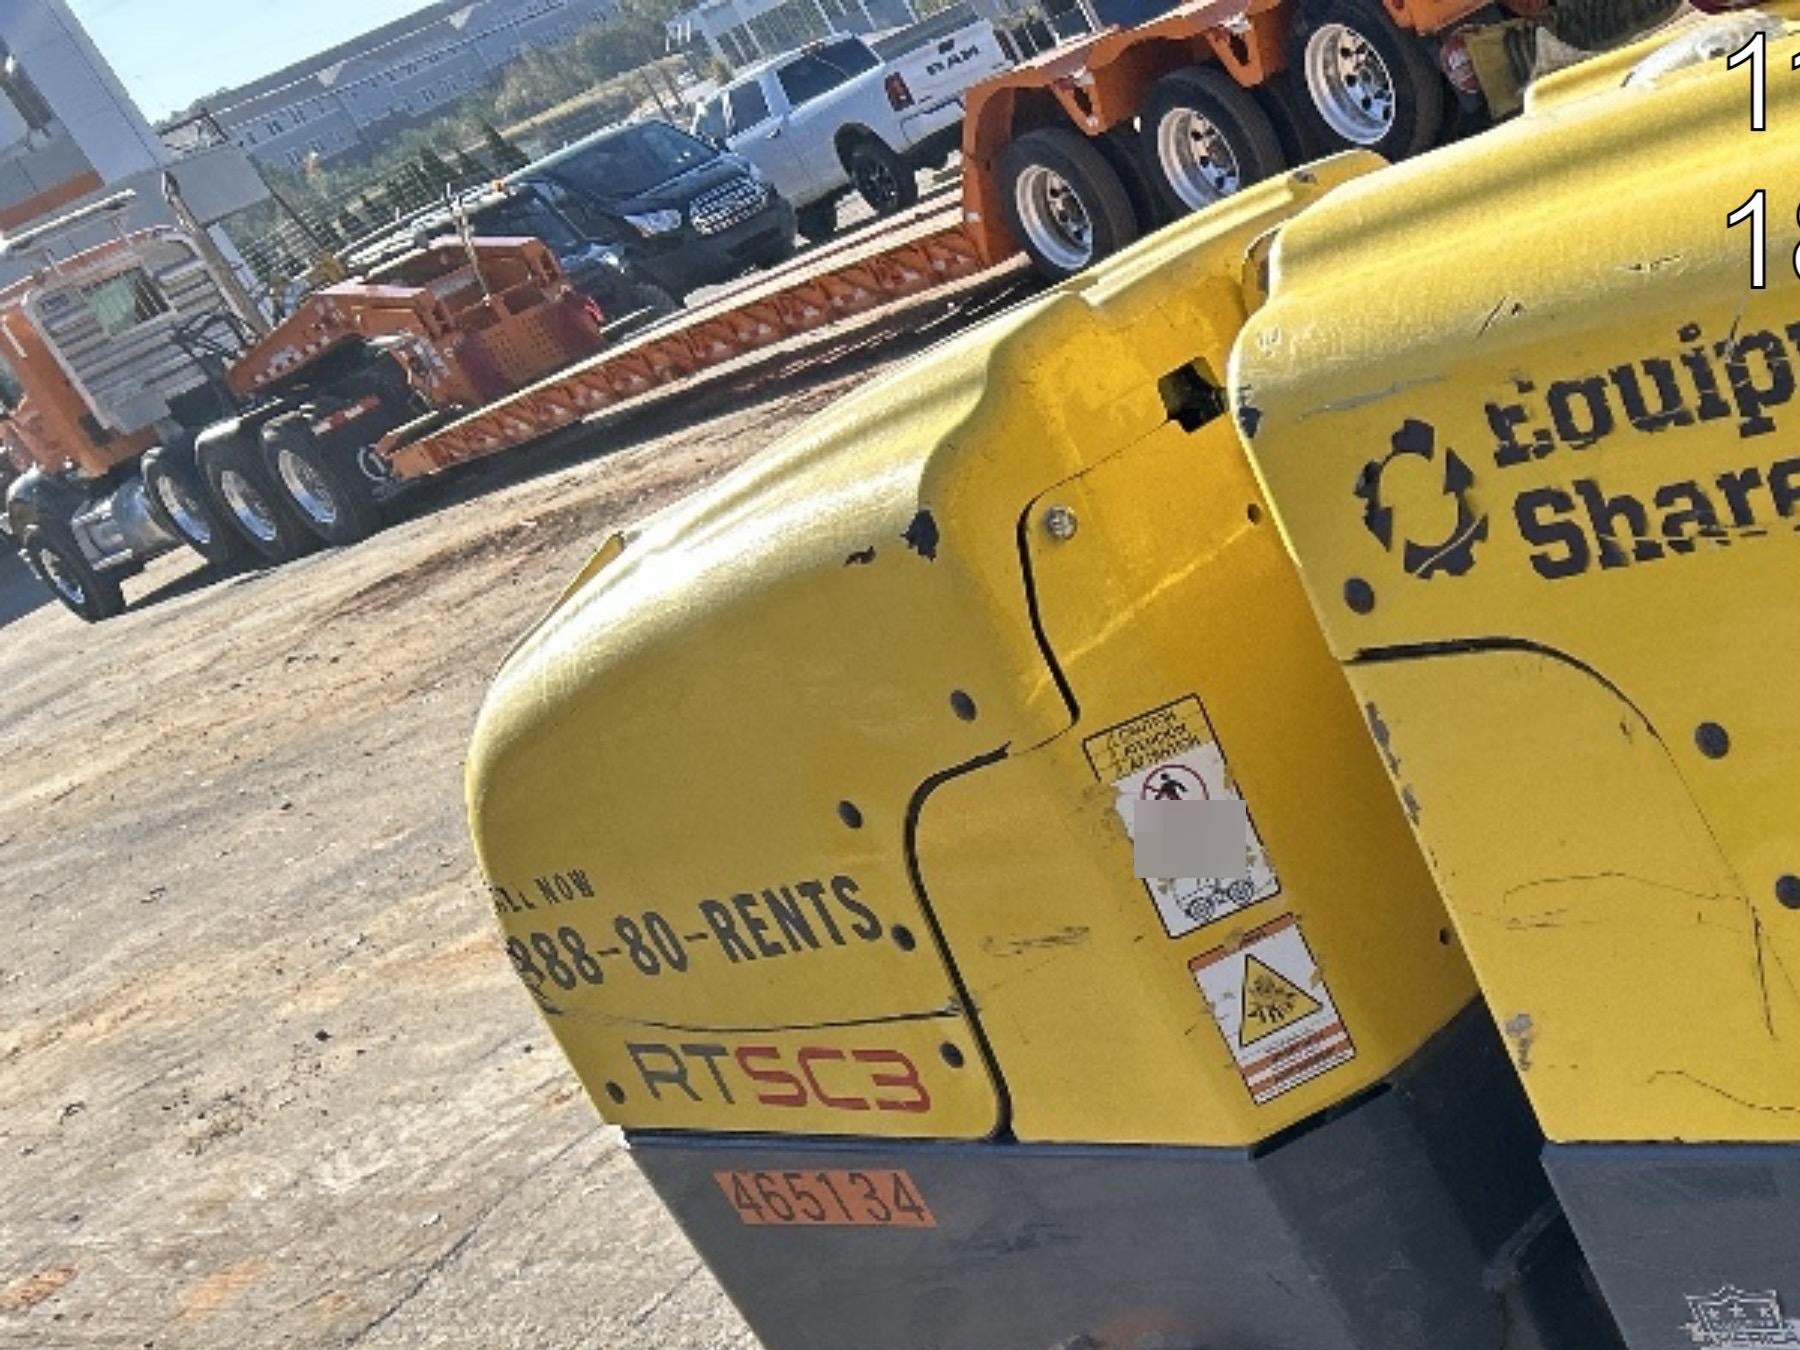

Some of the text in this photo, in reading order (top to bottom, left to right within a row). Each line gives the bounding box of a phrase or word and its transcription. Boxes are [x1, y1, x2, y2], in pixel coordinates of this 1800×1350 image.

[926, 45, 979, 76] RAM
[534, 869, 595, 904] NOW
[627, 1043, 931, 1113] RTSC3
[731, 1171, 926, 1223] 465134
